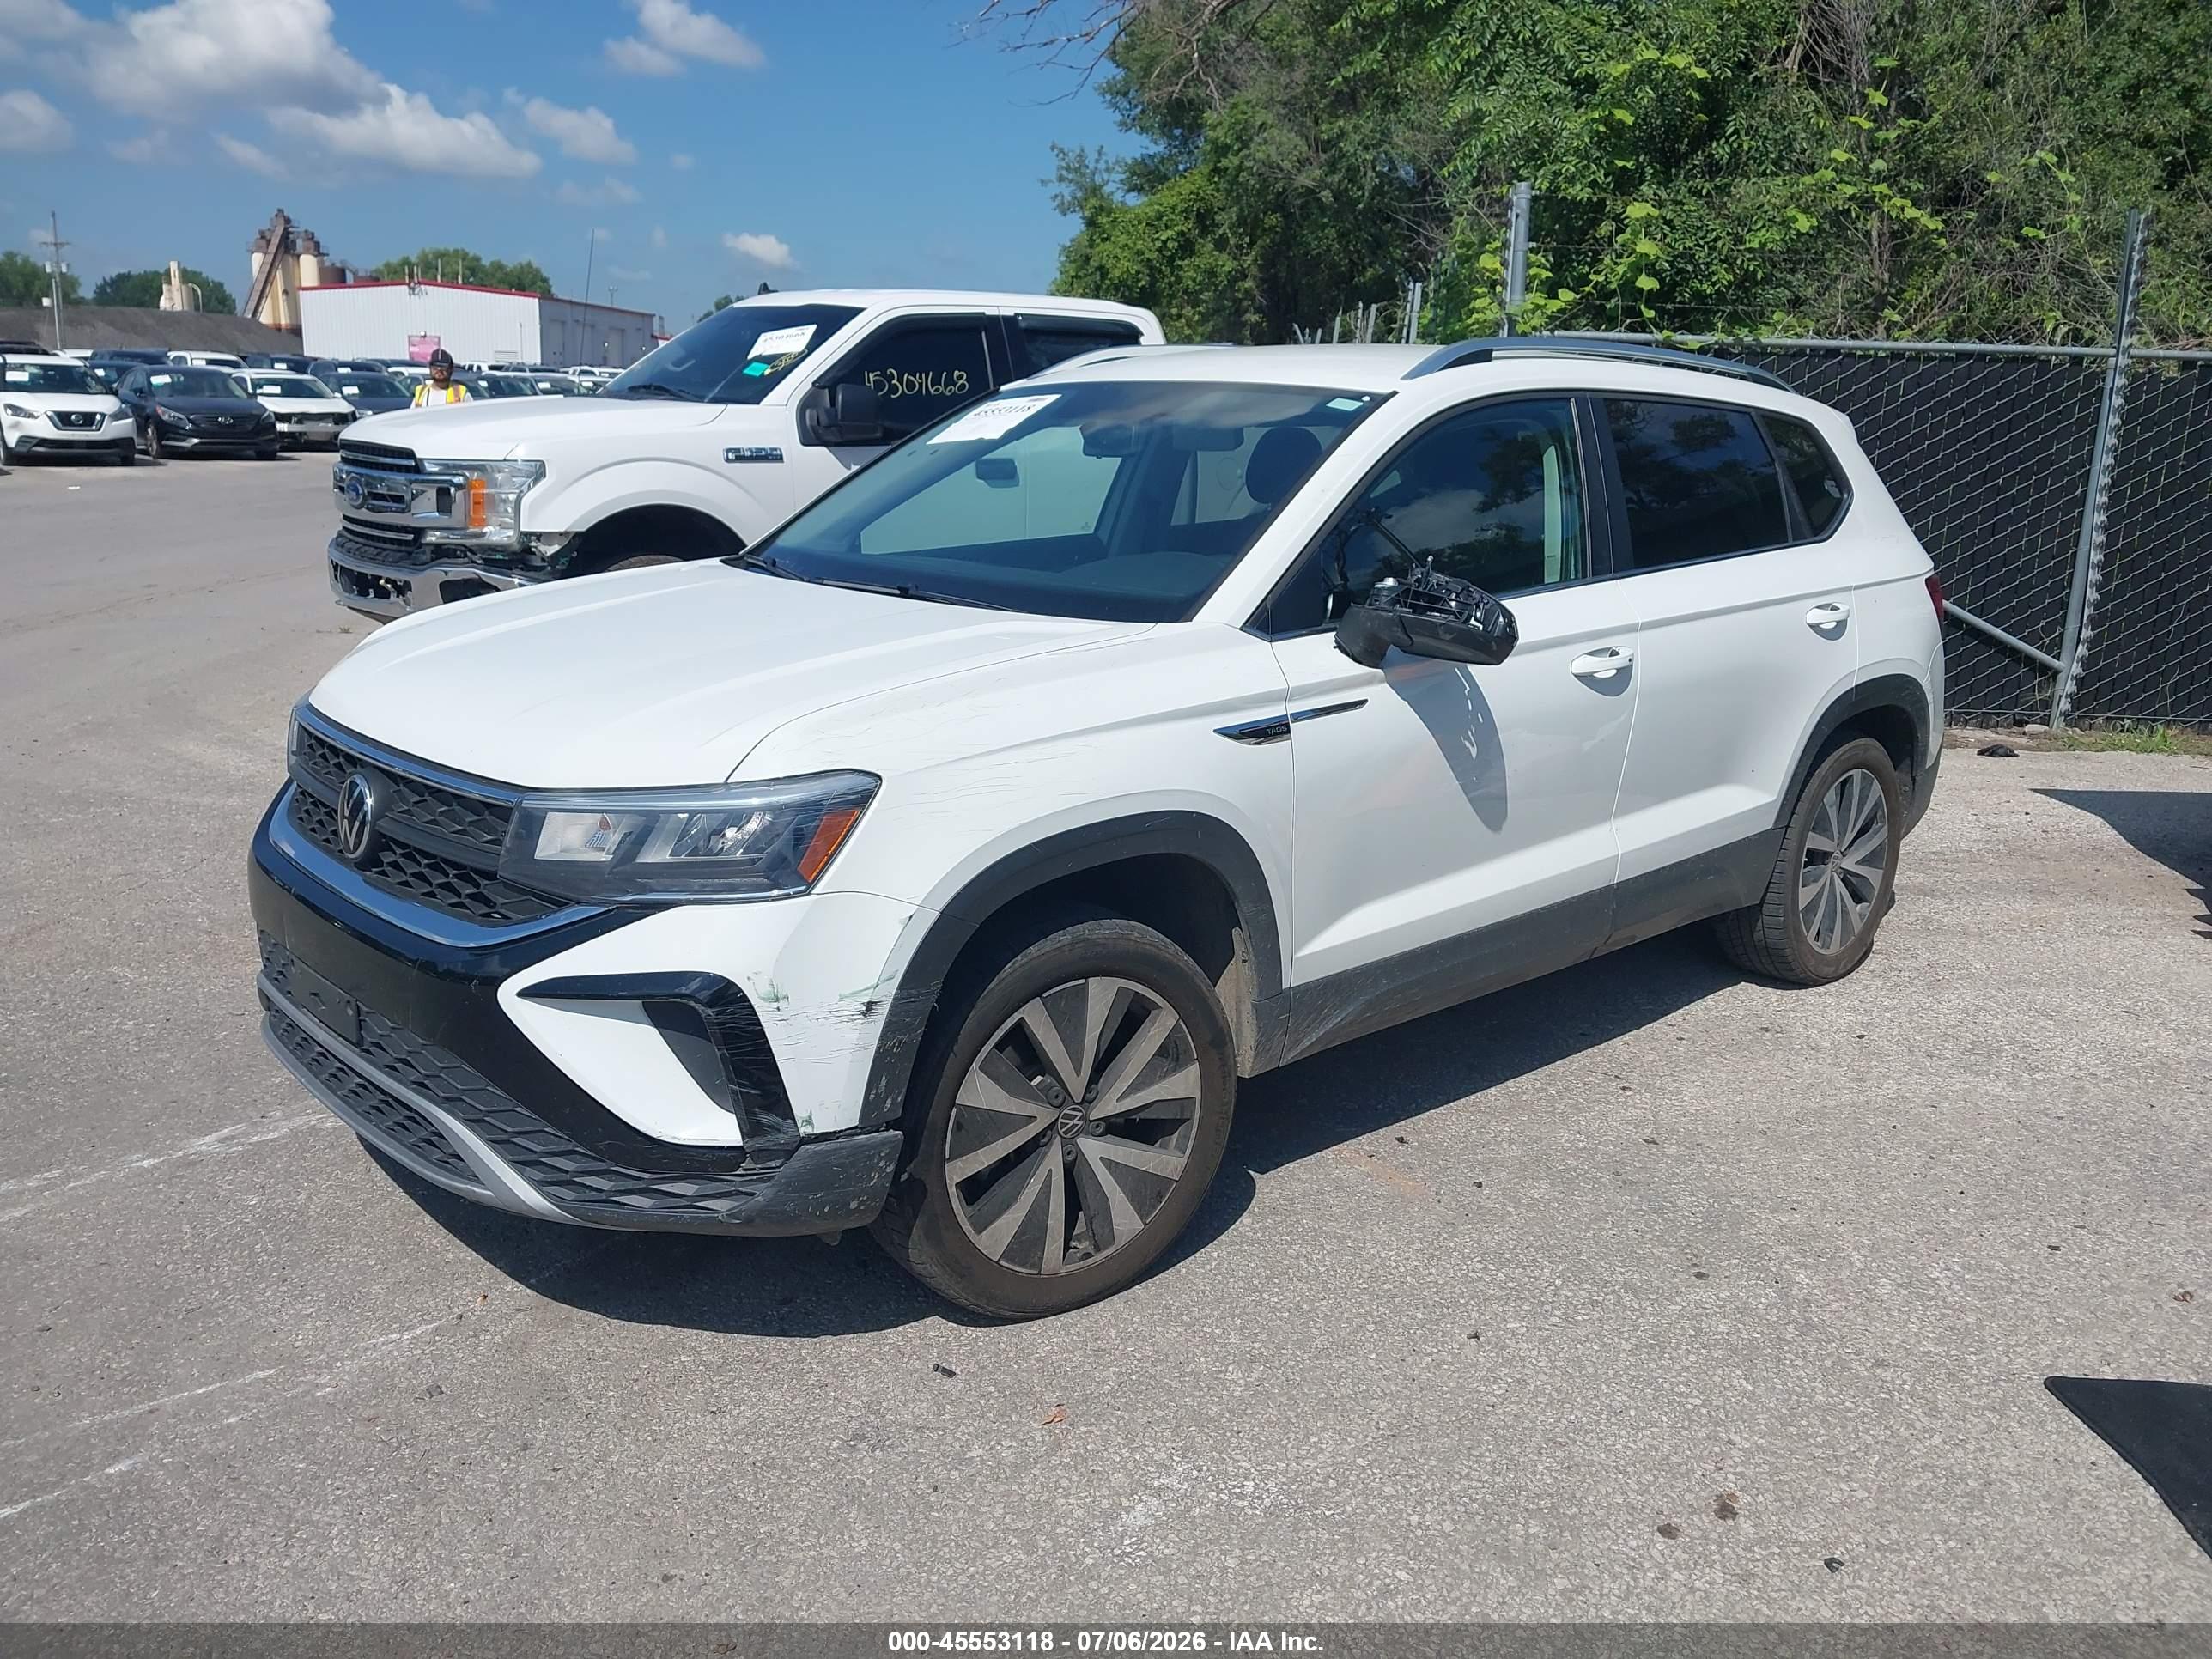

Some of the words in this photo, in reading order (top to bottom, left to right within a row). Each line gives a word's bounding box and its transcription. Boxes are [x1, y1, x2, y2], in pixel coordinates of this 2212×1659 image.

[865, 368, 969, 398] 45304668
[1266, 726, 1288, 735] TAOS
[338, 774, 374, 858] VW
